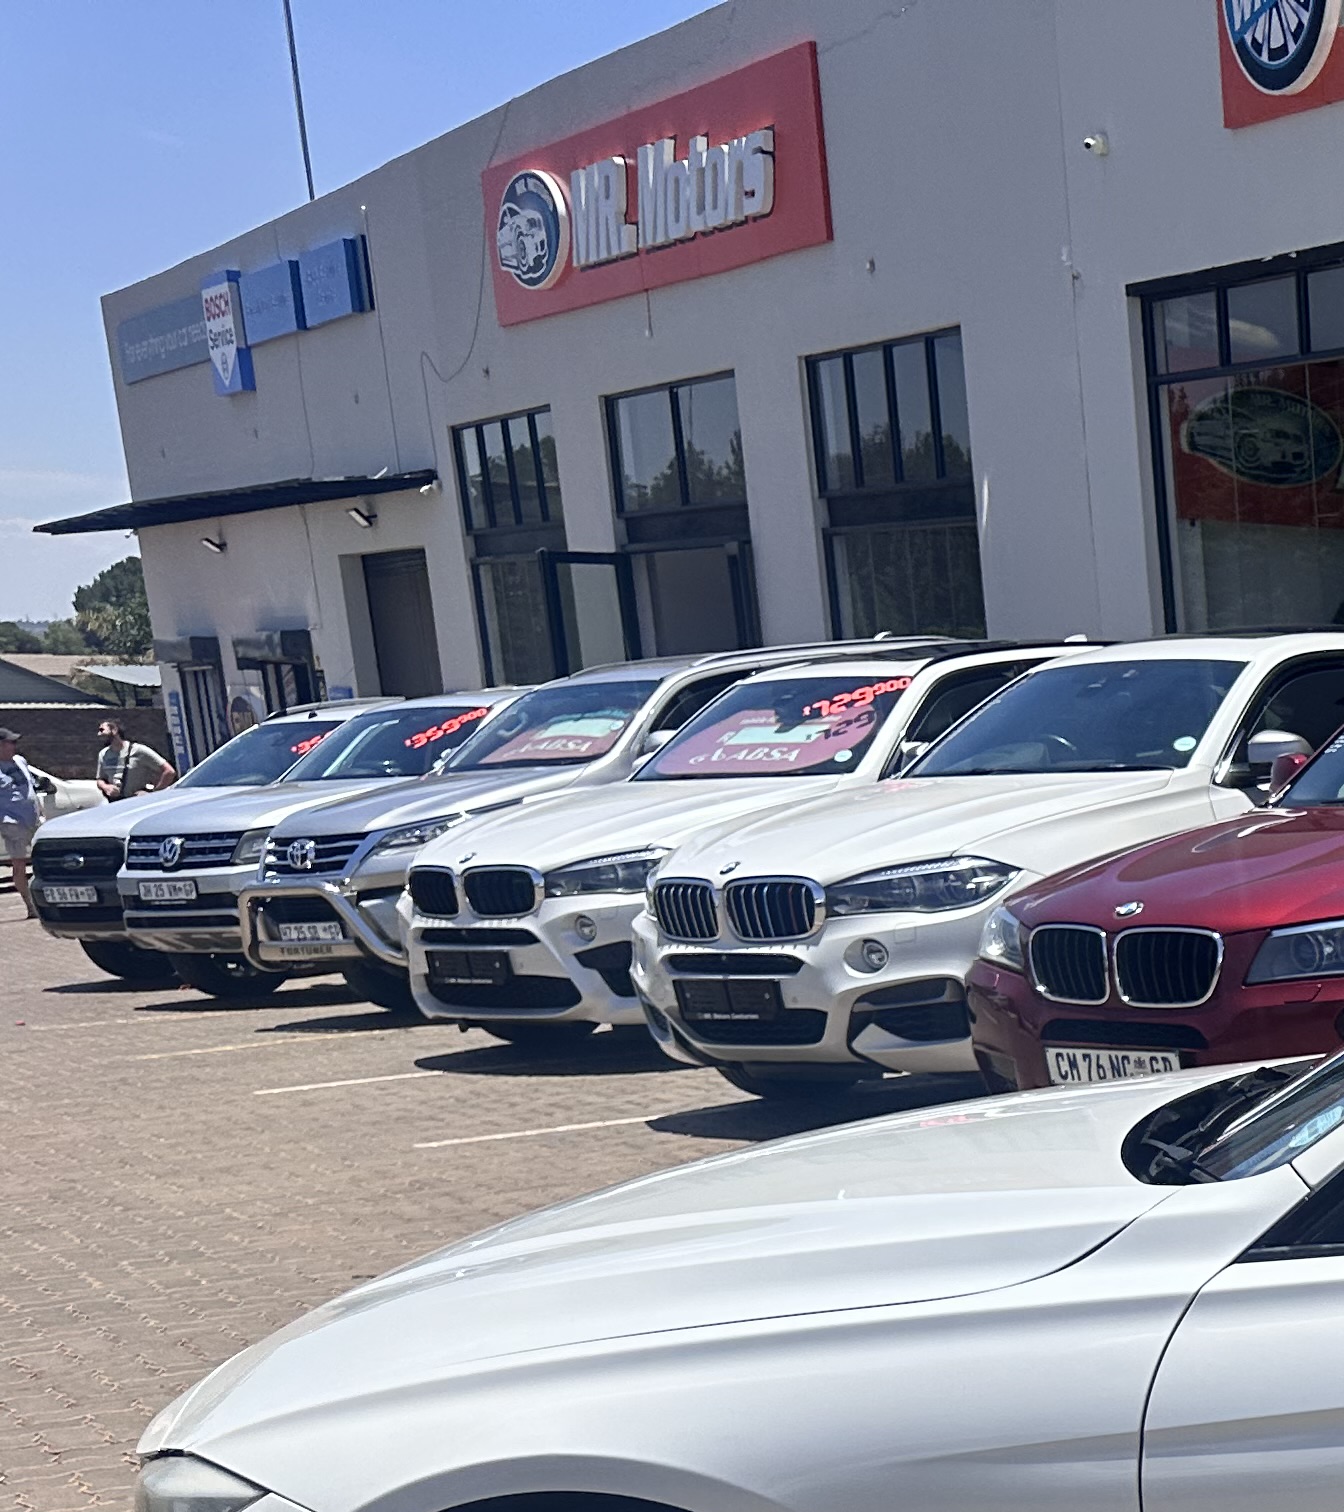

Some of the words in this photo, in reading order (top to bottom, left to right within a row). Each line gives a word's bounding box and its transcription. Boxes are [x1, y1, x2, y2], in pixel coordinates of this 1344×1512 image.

[571, 154, 639, 270] MR.
[637, 124, 774, 250] Motors
[204, 292, 231, 323] BOSCH
[208, 326, 235, 351] Service
[1055, 1052, 1081, 1082] CM
[1082, 1053, 1107, 1082] 76
